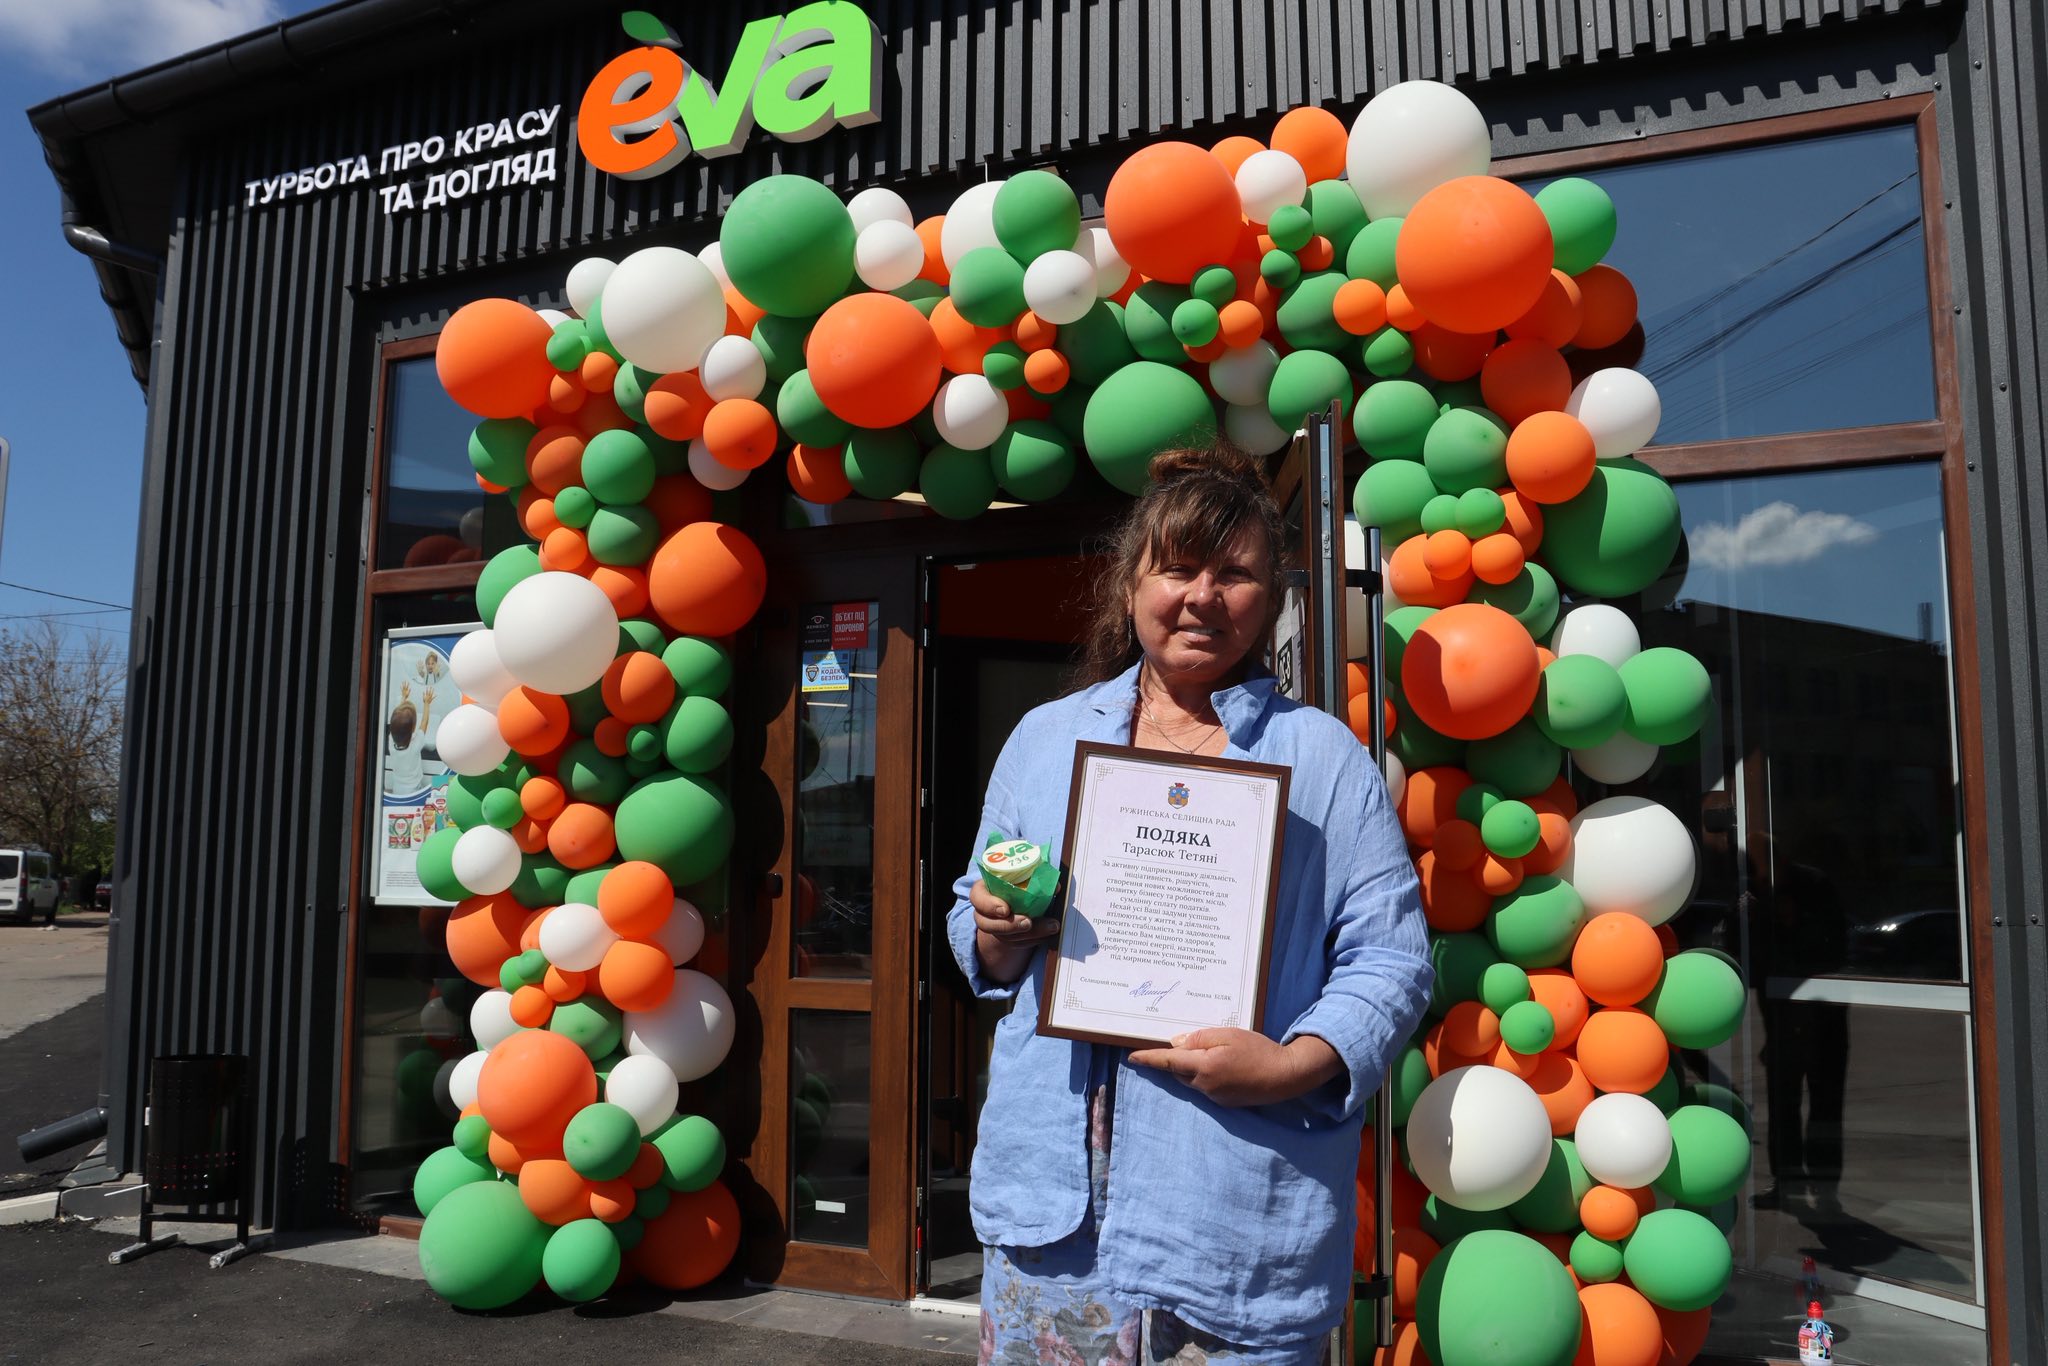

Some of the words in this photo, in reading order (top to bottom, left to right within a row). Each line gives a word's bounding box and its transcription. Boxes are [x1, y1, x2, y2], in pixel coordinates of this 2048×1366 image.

[245, 155, 370, 207] ТУРБОТА
[379, 133, 447, 176] ПРО
[453, 104, 561, 158] КРАСУ
[379, 184, 417, 215] ТА
[422, 147, 558, 210] ДОГЛЯД
[1120, 807, 1170, 818] РУЖИНСЬКА
[1172, 813, 1212, 824] СЕЛИЩНА
[1215, 819, 1236, 827] РАДА
[1135, 826, 1212, 849] ПОДЯКА
[1008, 855, 1029, 867] 736
[1121, 842, 1175, 860] Тарасюк
[1178, 849, 1218, 863] Тетяні
[1111, 862, 1138, 871] активну
[1140, 865, 1198, 879] підприємницьку
[1105, 886, 1137, 896] розвитку
[1138, 889, 1164, 898] бізнесу
[1175, 894, 1204, 904] робочих
[1106, 878, 1142, 887] створення
[1167, 885, 1214, 896] можливостей
[1120, 896, 1152, 905] сумлінну
[1153, 900, 1177, 909] сплату
[1106, 911, 1146, 921] втілюються
[1154, 917, 1177, 925] життя,
[1184, 921, 1220, 931] діяльність
[1109, 902, 1131, 910] Нехай
[1132, 905, 1142, 913] усі
[1162, 910, 1186, 919] задуми
[1188, 912, 1217, 922] успішно
[1092, 918, 1130, 928] приносить
[1132, 922, 1174, 933] стабільність
[1107, 927, 1138, 936] Бажаємо
[1092, 942, 1128, 953] добробуту
[1161, 951, 1194, 961] успішних
[1110, 953, 1121, 961] під
[1122, 954, 1151, 964] мирним
[1153, 958, 1175, 967] небом
[1177, 960, 1206, 971] України!
